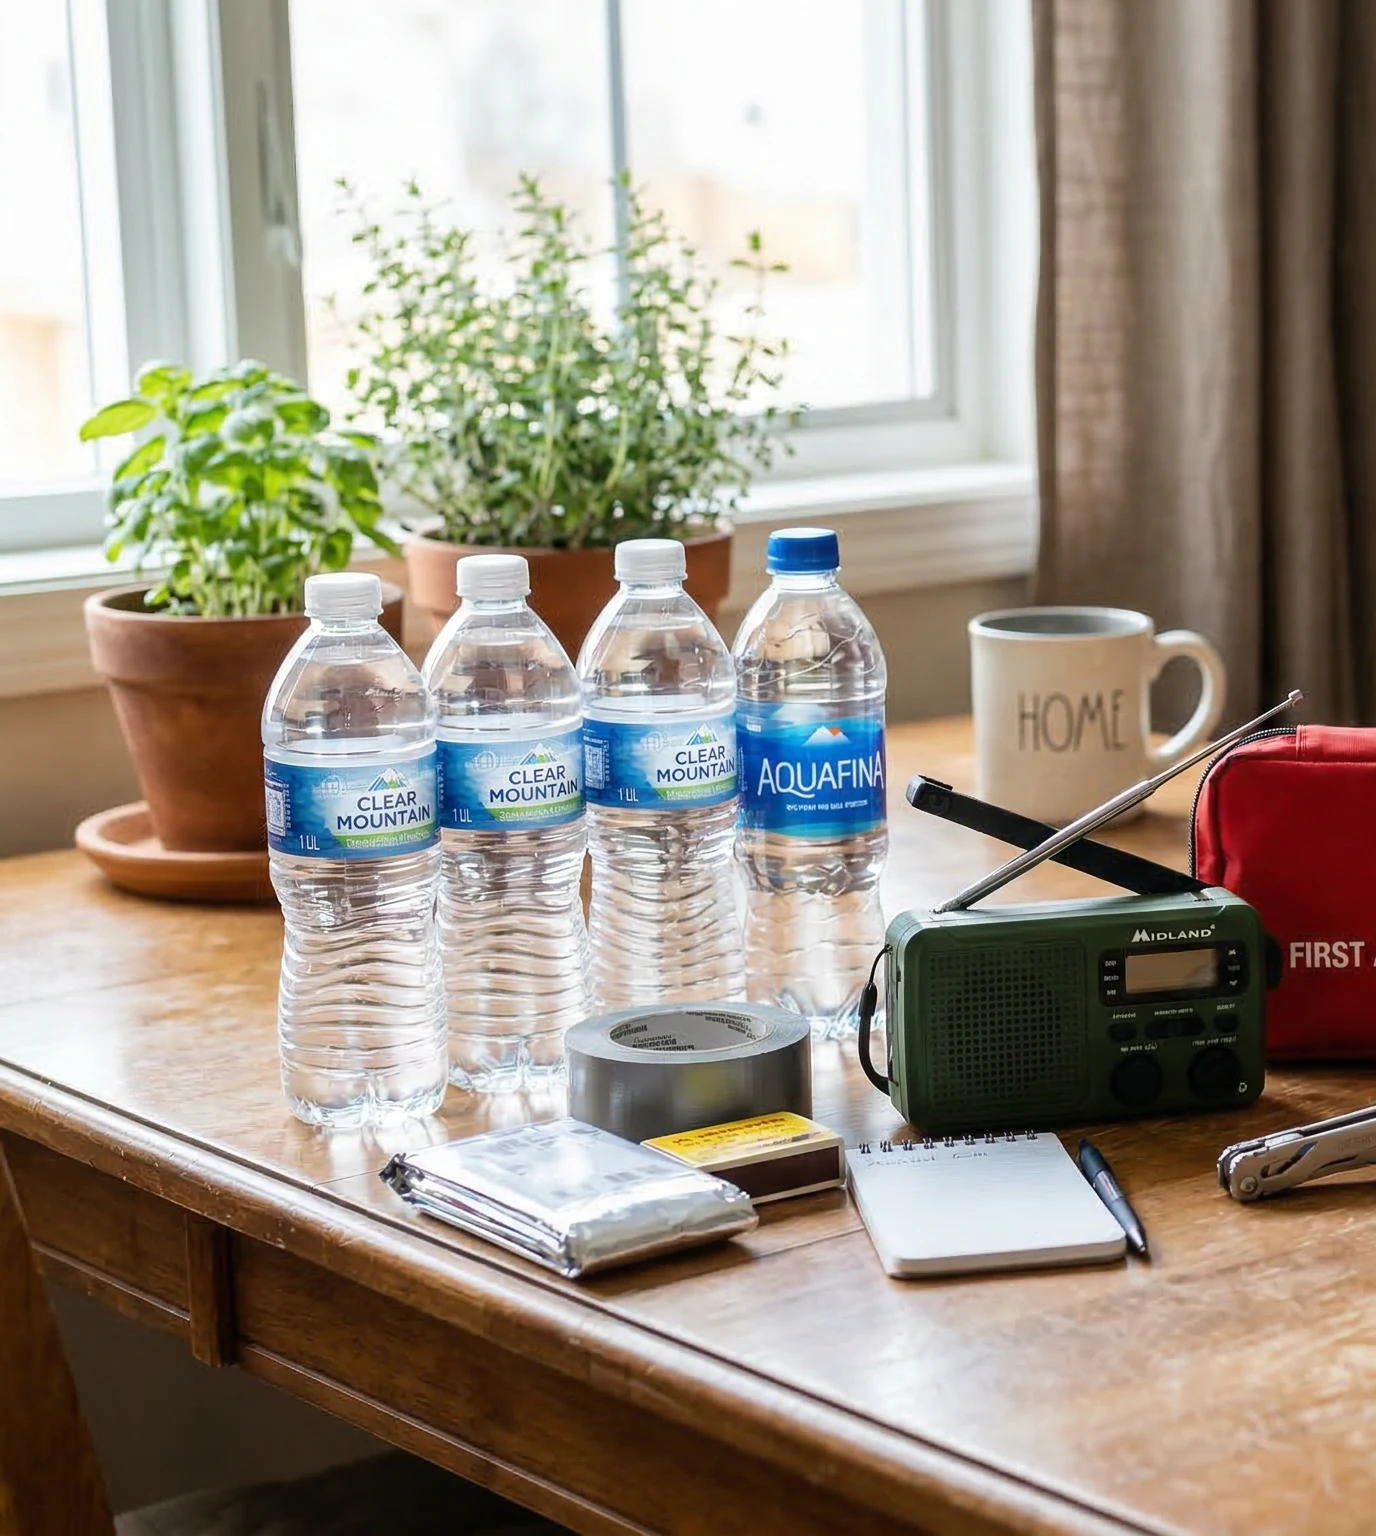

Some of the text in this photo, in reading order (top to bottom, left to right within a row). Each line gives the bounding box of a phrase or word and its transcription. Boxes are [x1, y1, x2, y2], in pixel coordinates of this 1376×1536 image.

[1017, 688, 1129, 752] HOME
[675, 745, 726, 765] CLEAR
[508, 765, 566, 785] CLEAR
[656, 757, 735, 783] MOUNTAIN
[757, 750, 884, 798] AQUAFINA
[357, 790, 417, 812] CLEAR
[489, 777, 578, 803] MOUNTAIN
[337, 808, 431, 830] MOUNTAIN
[1131, 928, 1212, 942] MIDLAND
[1290, 941, 1363, 968] FIRST
